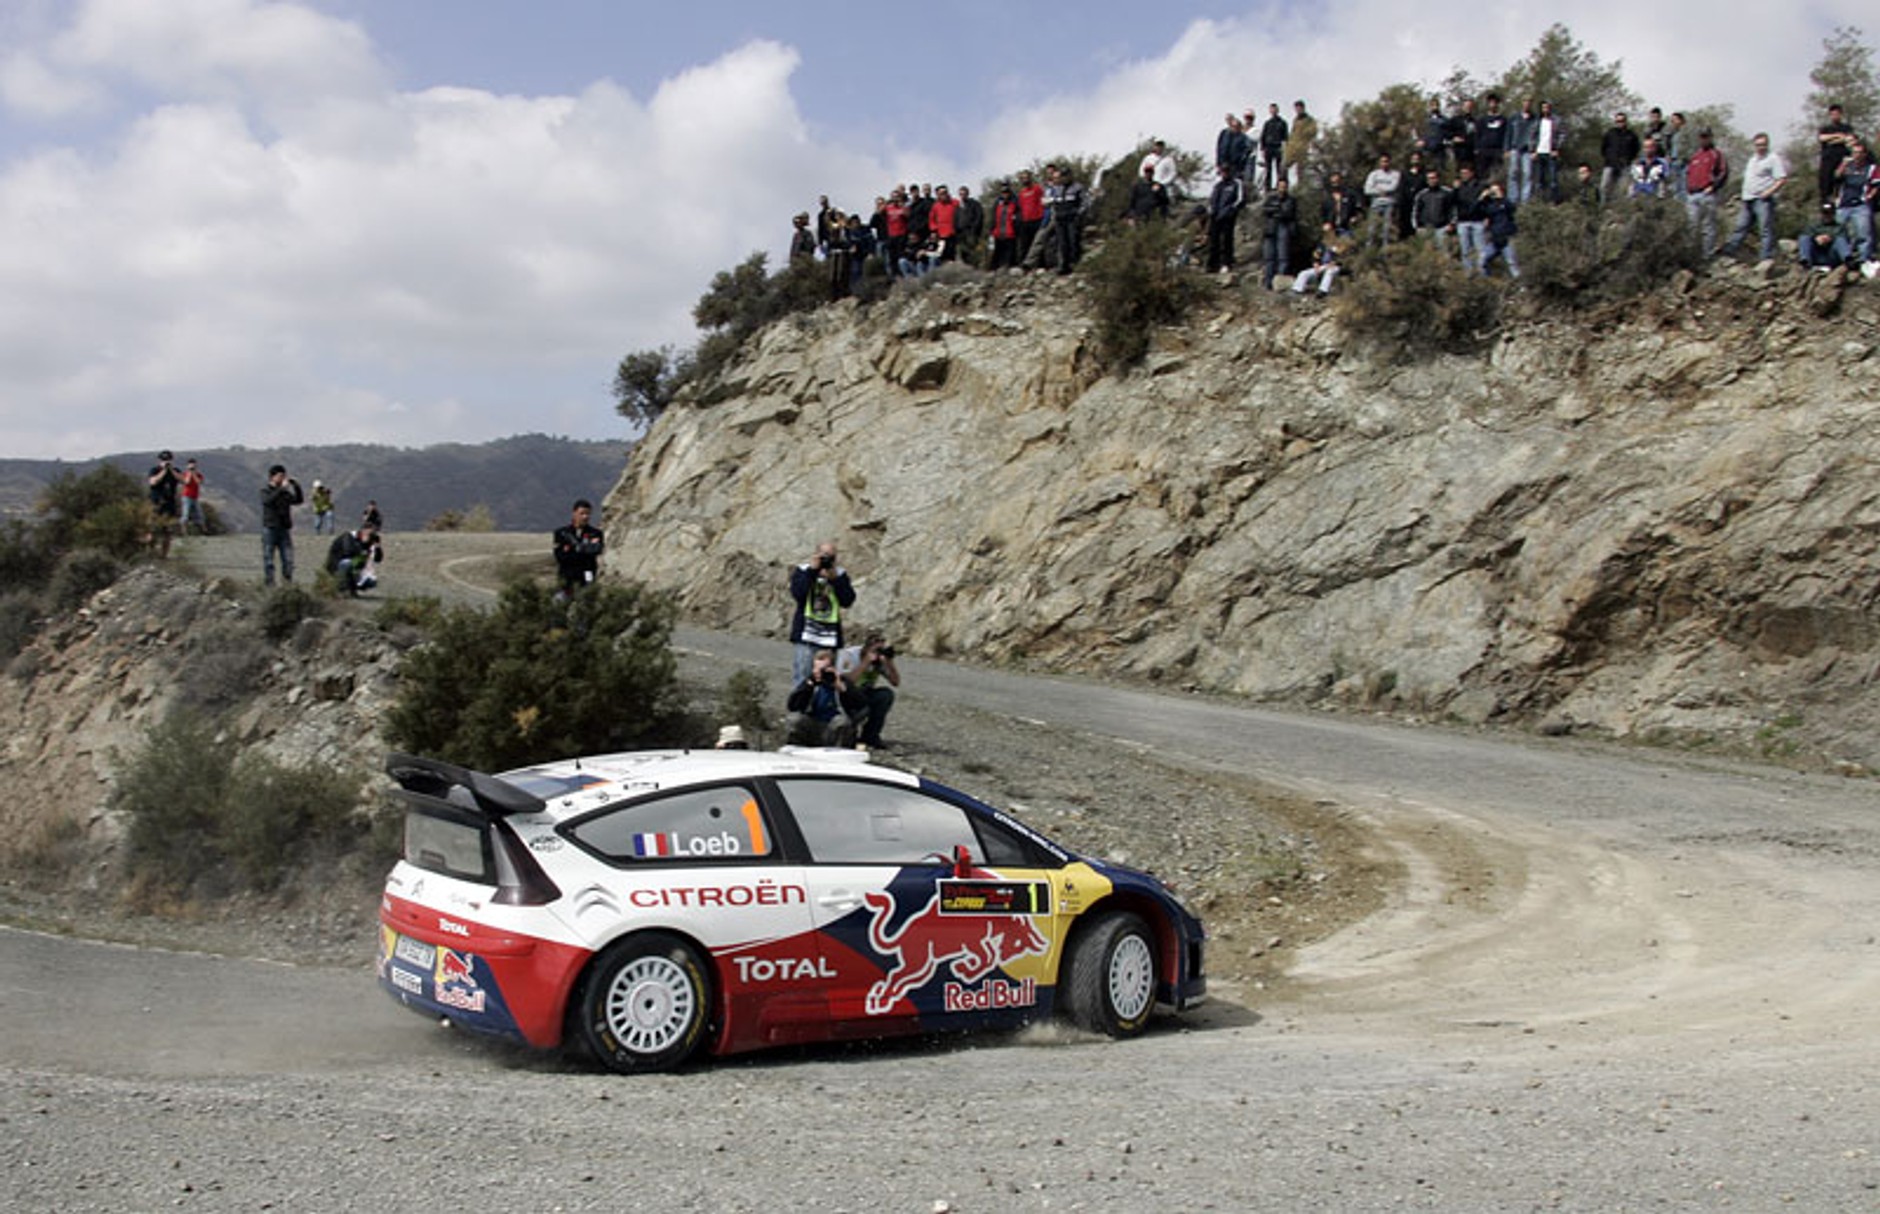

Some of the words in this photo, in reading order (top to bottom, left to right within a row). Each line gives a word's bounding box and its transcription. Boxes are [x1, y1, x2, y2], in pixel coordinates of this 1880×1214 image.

[741, 799, 767, 855] 1
[671, 831, 740, 856] Loeb
[1026, 882, 1038, 913] 1
[733, 956, 838, 983] TOTAL
[944, 979, 990, 1012] Red
[991, 976, 1036, 1008] Bull
